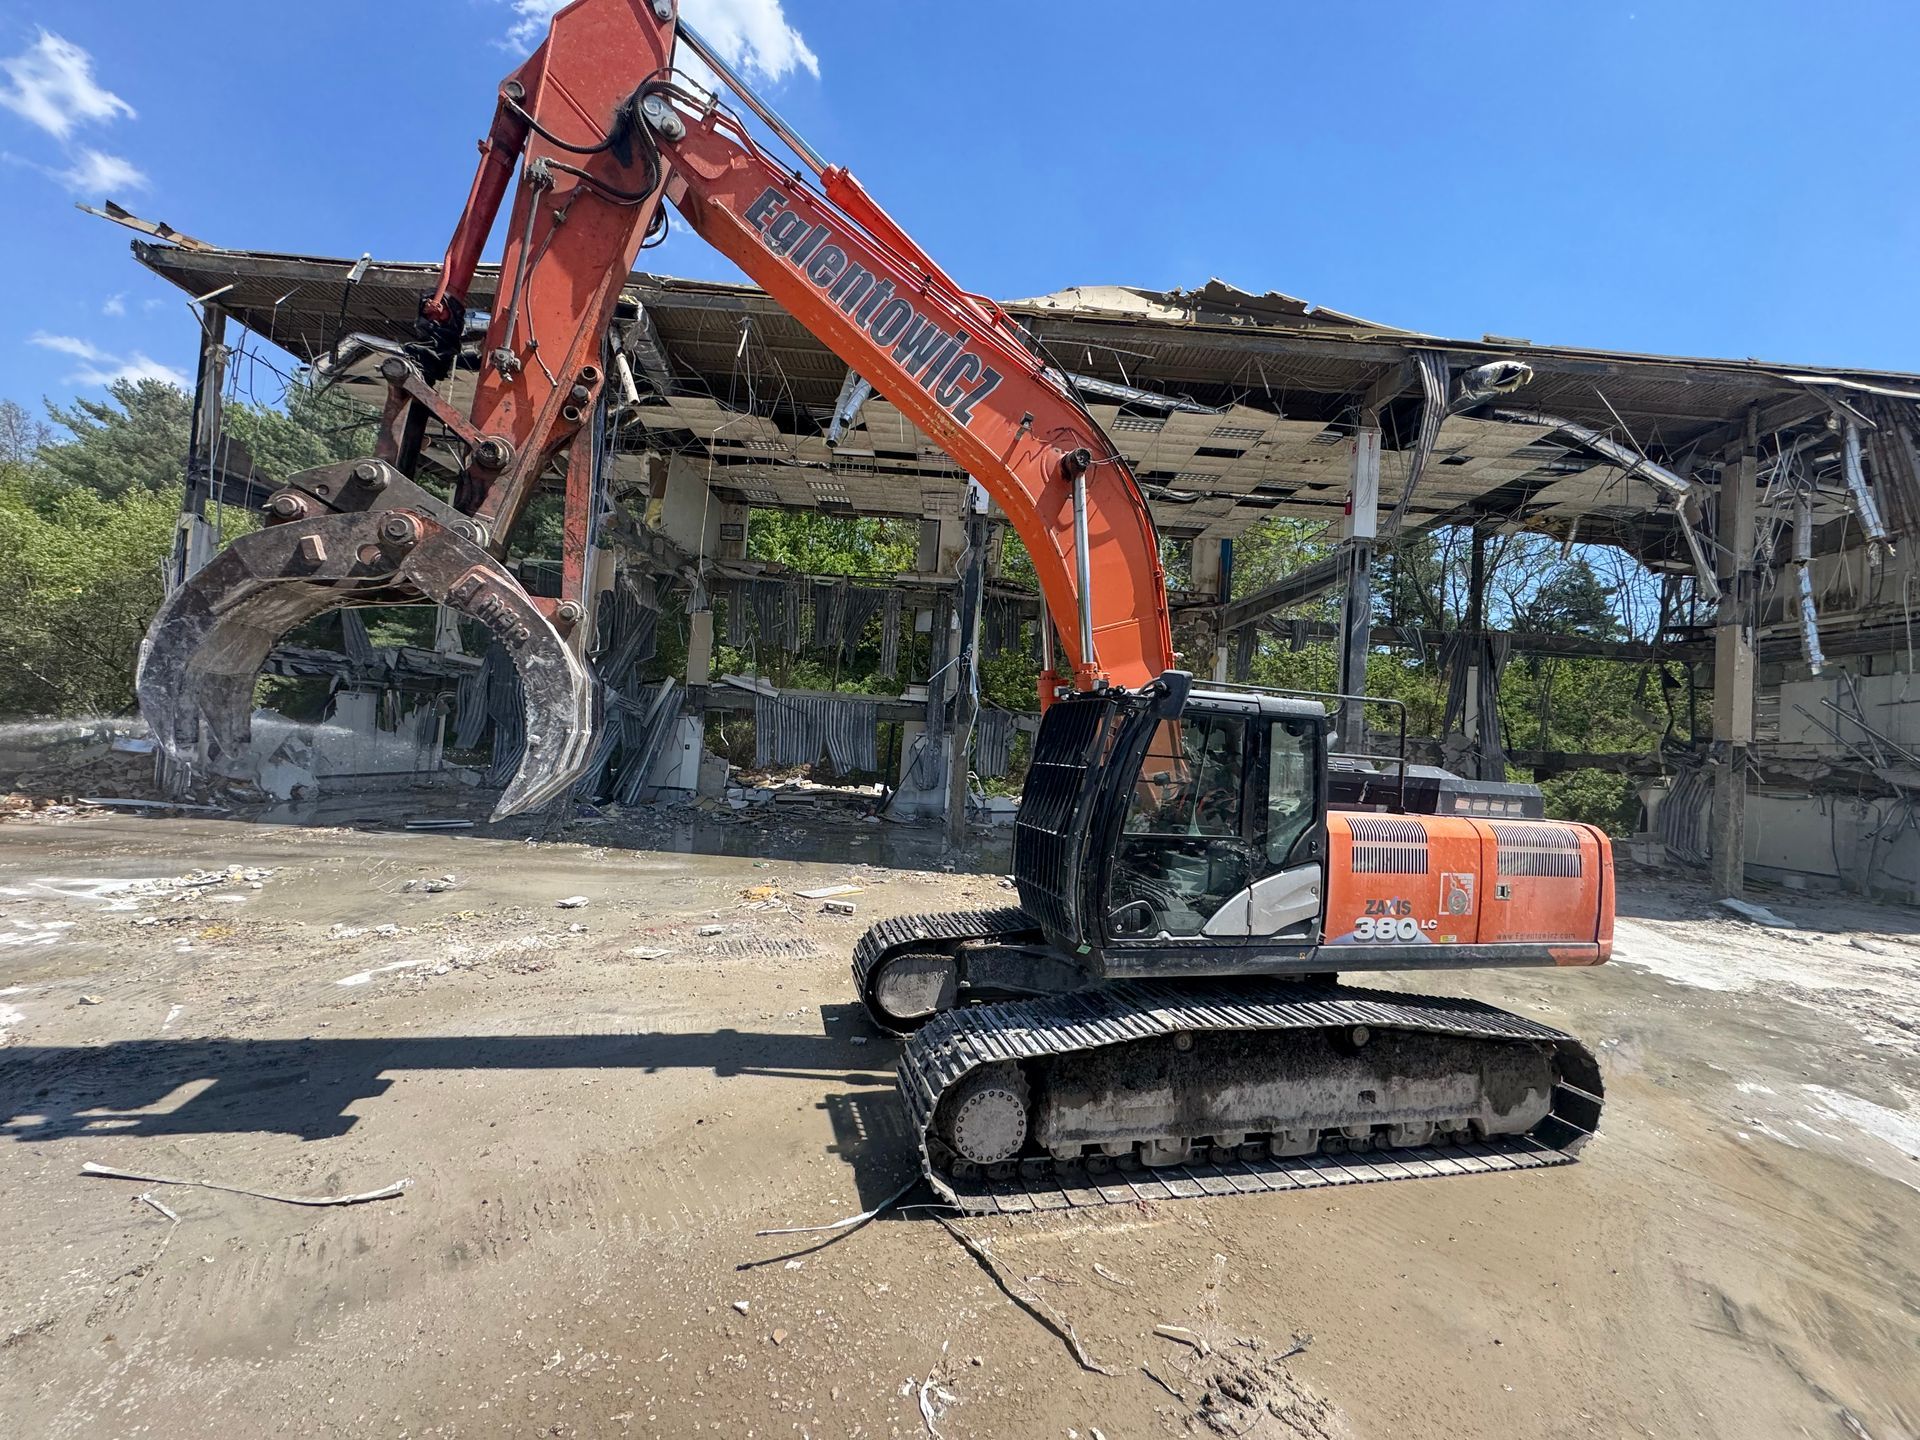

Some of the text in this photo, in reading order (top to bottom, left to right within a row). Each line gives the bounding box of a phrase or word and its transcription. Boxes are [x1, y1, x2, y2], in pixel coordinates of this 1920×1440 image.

[743, 186, 1004, 427] Eglentowicz
[1365, 896, 1412, 915] ZAXIS
[1353, 917, 1439, 942] 380 LC
